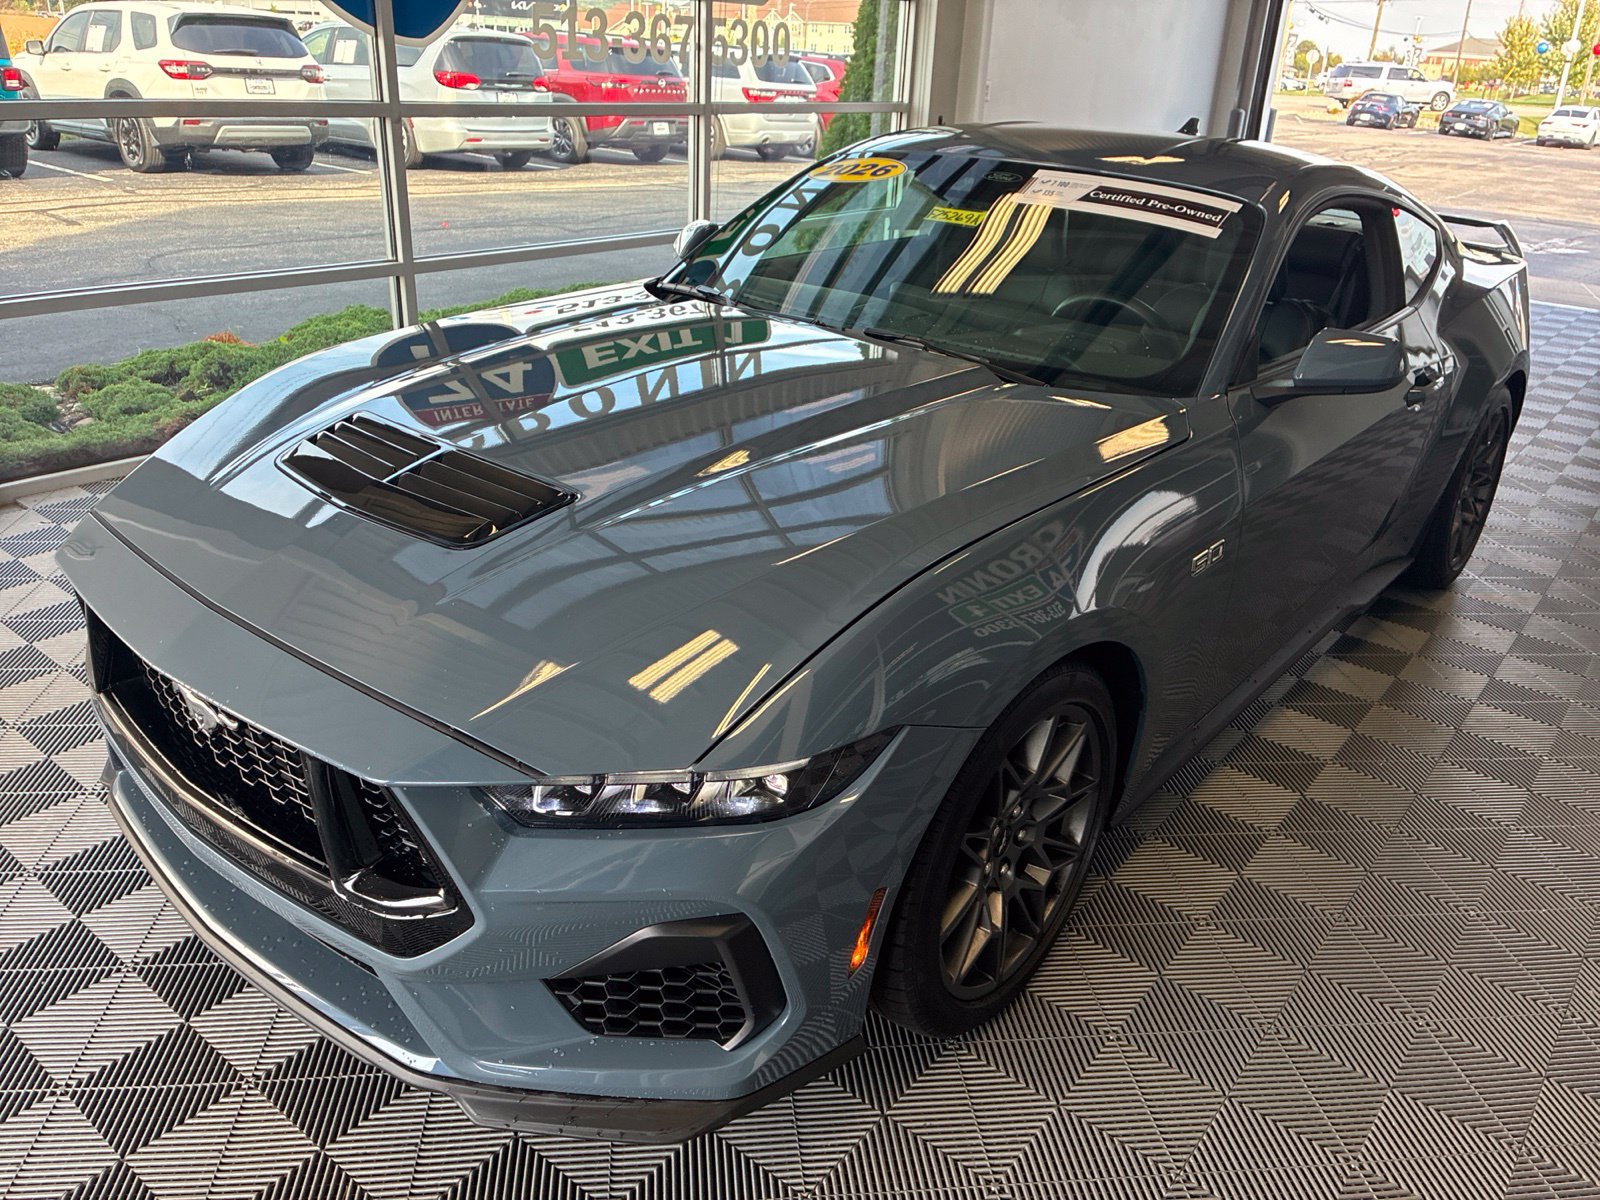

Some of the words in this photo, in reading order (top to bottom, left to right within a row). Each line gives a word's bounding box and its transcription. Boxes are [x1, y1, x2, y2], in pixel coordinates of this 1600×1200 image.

[815, 163, 898, 177] 2026
[1089, 190, 1146, 205] Certified
[1147, 199, 1222, 222] Pre-Owned
